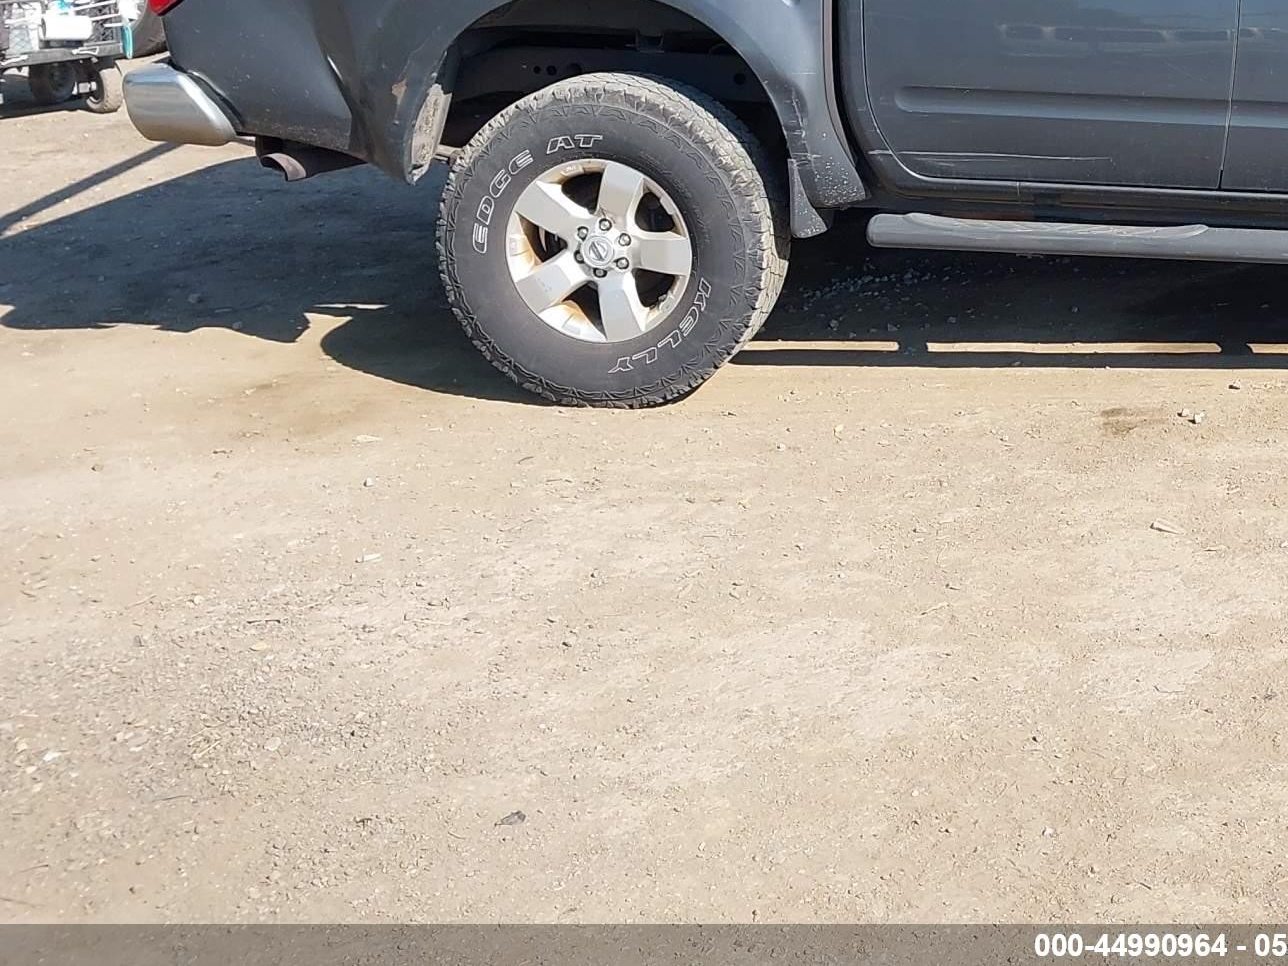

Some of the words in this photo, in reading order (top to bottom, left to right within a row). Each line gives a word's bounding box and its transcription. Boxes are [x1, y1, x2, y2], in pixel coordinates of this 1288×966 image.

[472, 149, 533, 254] EDGE
[546, 133, 603, 155] AT
[608, 278, 712, 374] KELLY
